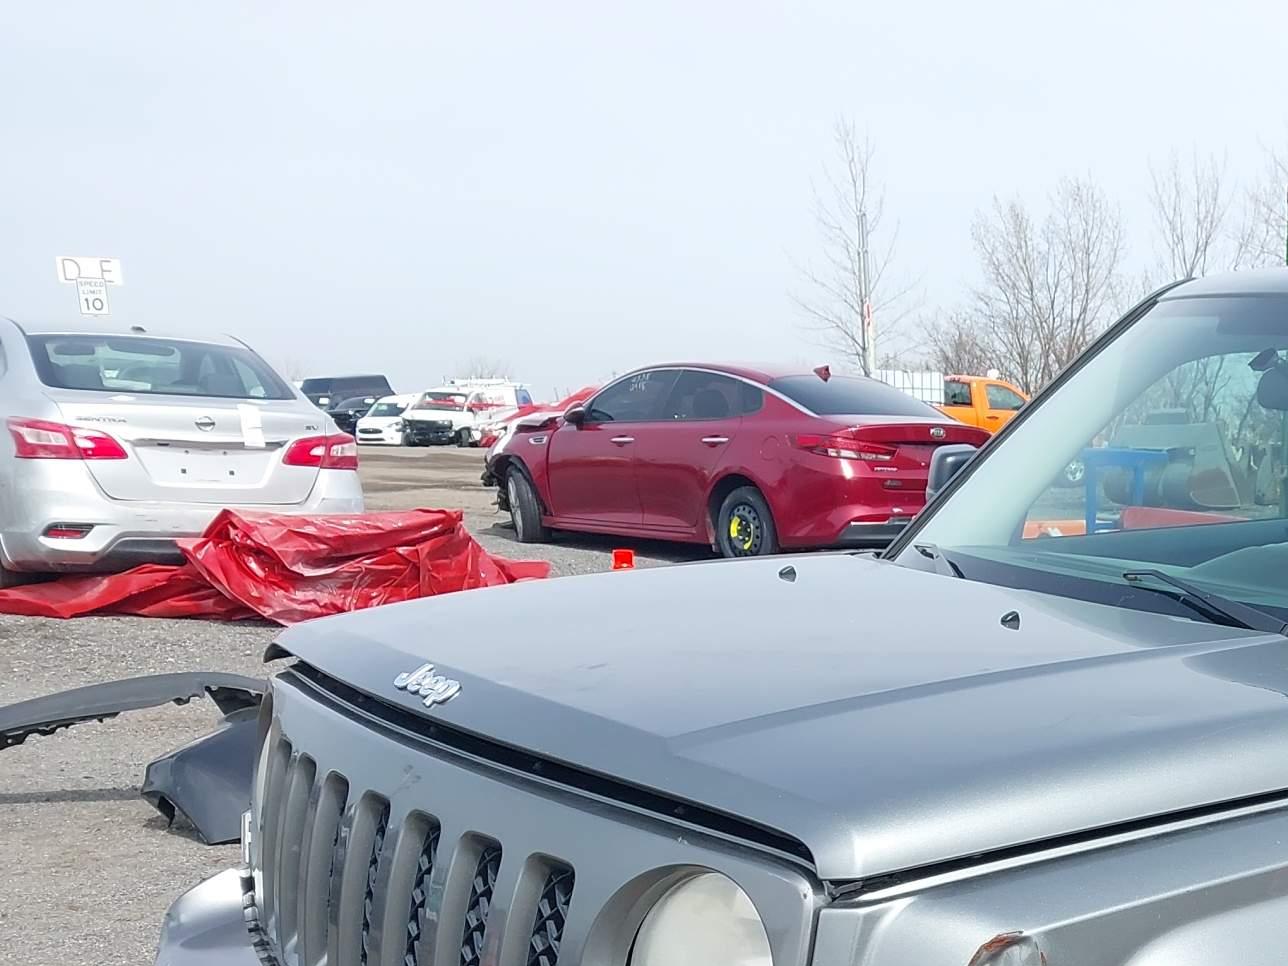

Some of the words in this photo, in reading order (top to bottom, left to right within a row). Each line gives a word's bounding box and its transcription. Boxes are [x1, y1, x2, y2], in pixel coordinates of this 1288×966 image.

[61, 258, 81, 281] D
[84, 297, 104, 311] 10
[393, 662, 461, 706] Jeep
